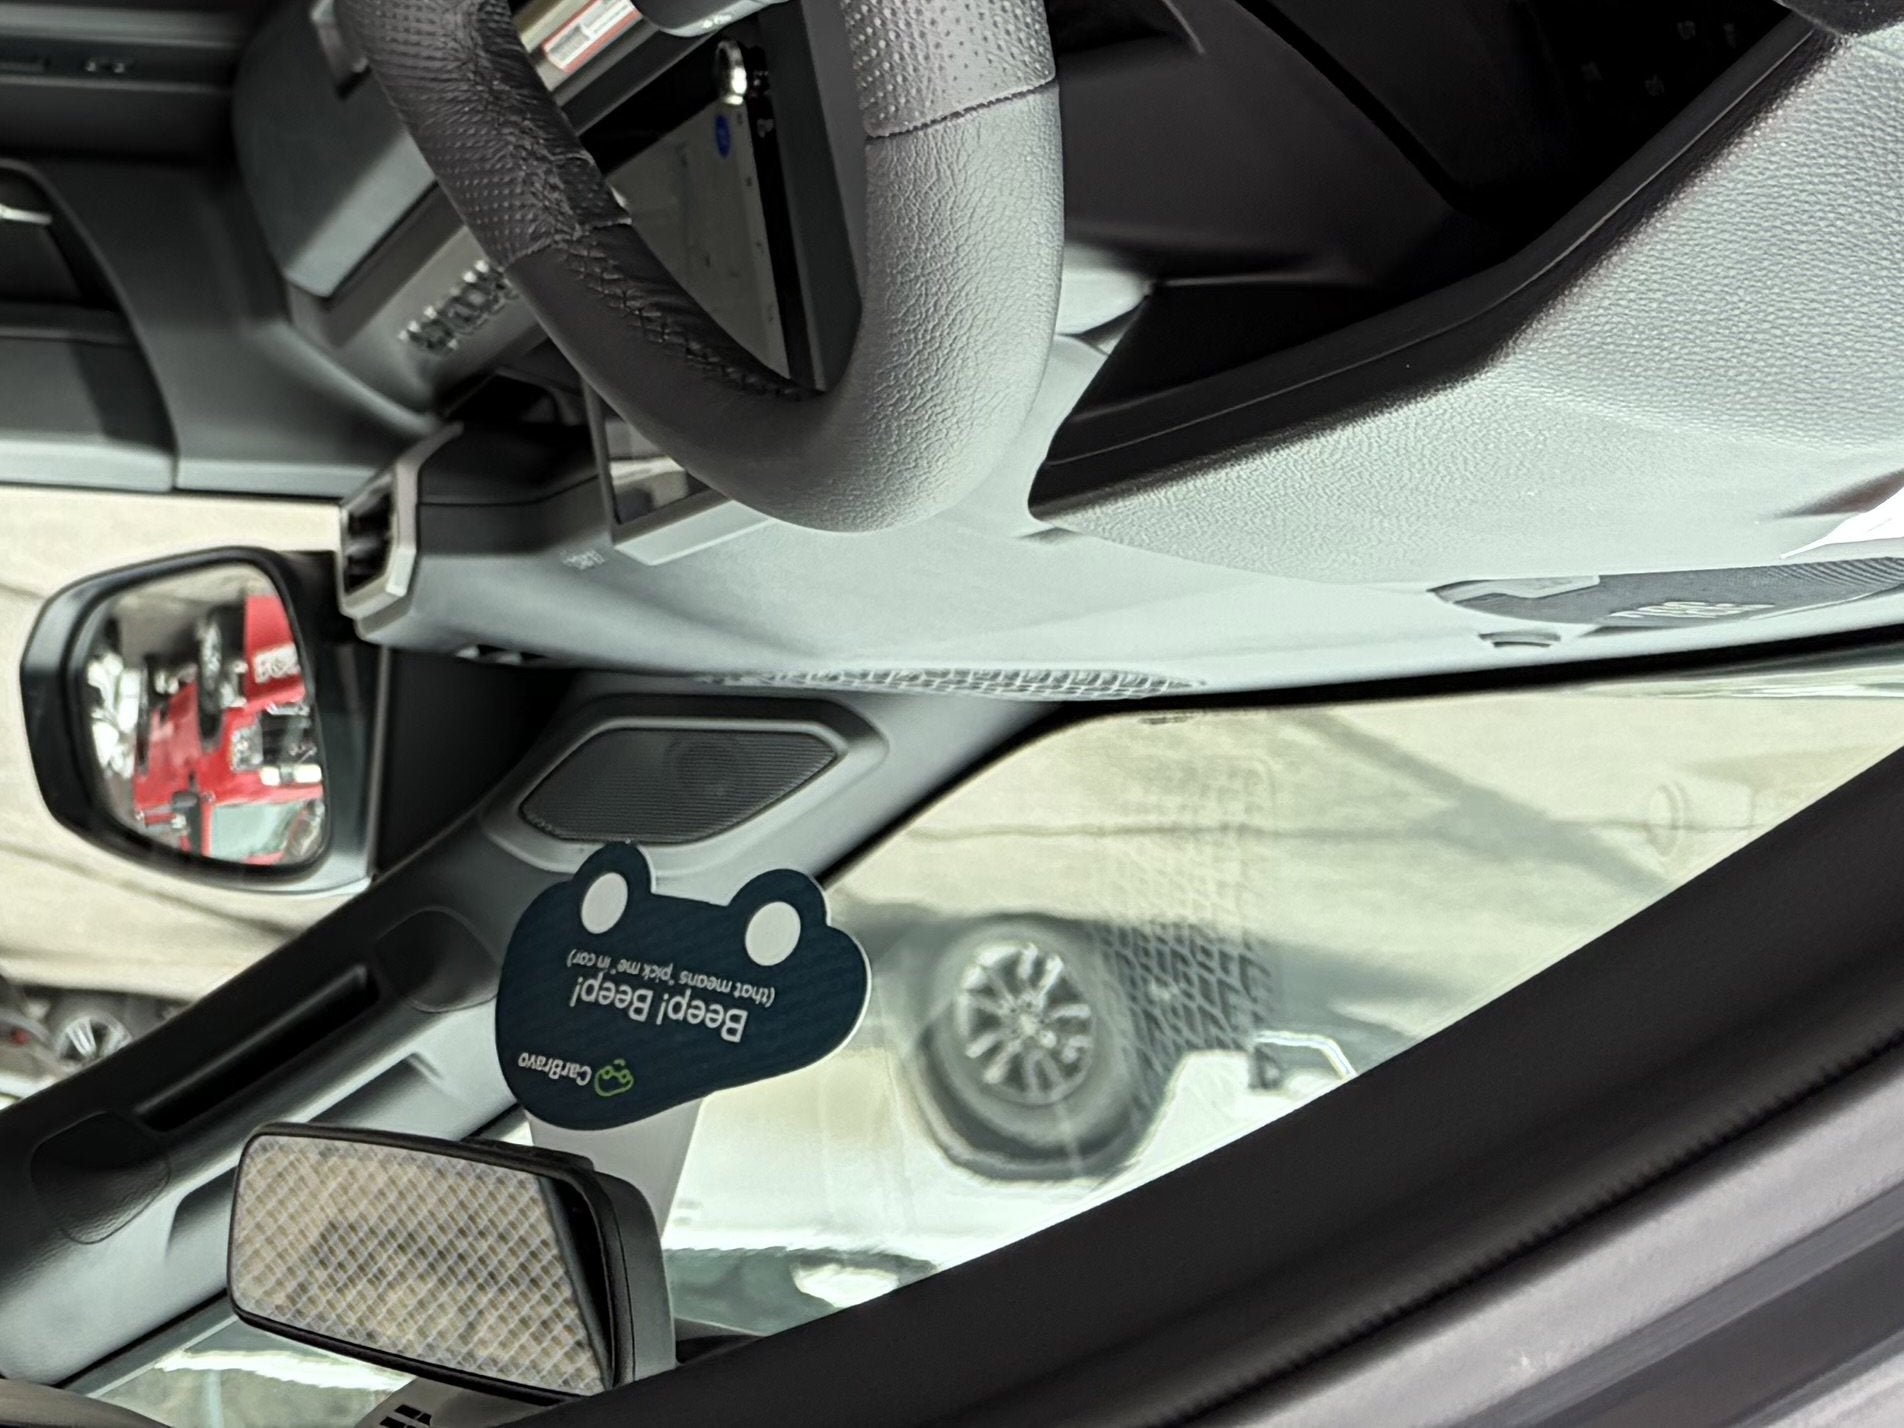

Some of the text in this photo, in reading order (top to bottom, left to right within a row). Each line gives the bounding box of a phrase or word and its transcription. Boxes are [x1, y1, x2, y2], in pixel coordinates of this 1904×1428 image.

[566, 948, 596, 968] car)
[596, 955, 610, 970] in
[679, 969, 733, 994] means
[733, 981, 776, 1008] (that
[569, 970, 749, 1043] Beep! Beep!
[517, 1051, 593, 1087] CarBravo
